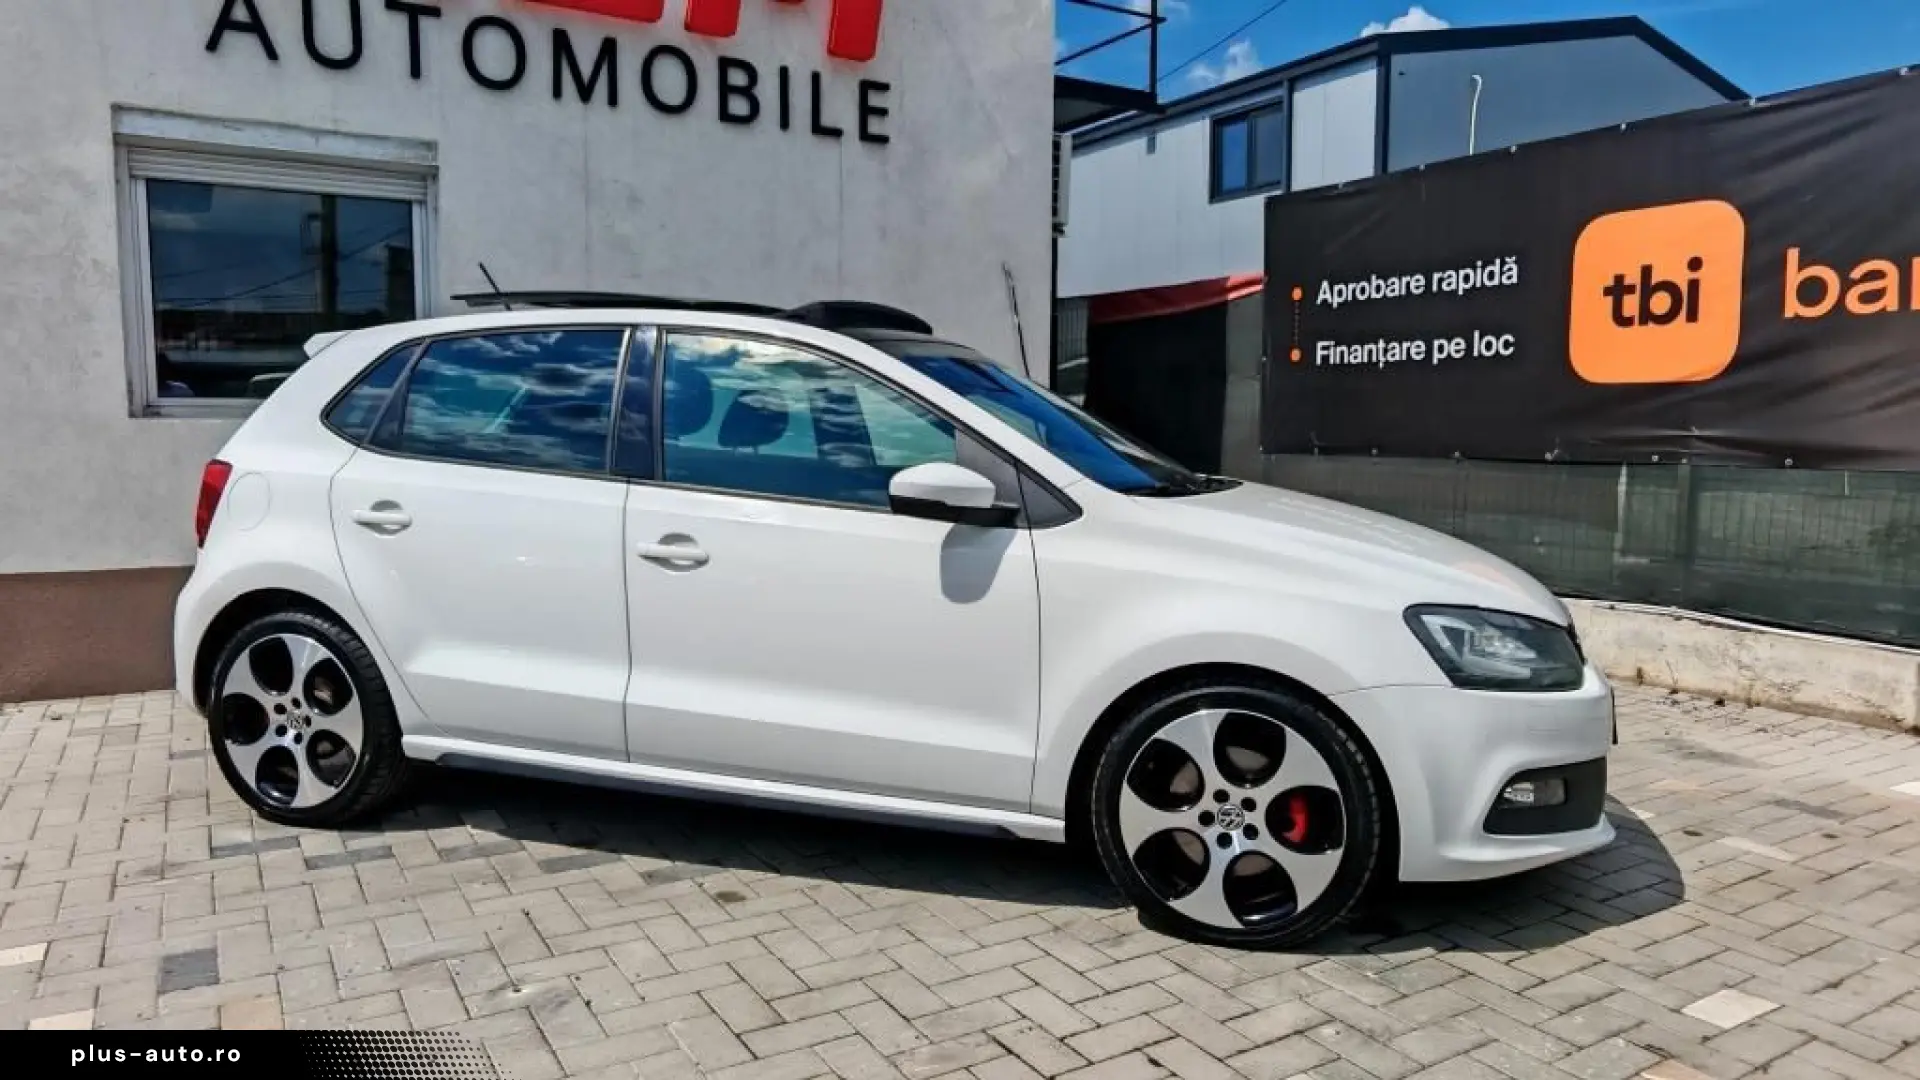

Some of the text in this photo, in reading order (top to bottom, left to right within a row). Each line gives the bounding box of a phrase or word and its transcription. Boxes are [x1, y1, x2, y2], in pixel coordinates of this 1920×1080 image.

[205, 0, 891, 145] AUTOMOBILE
[1316, 255, 1519, 309] Aprobare rapidă
[1602, 247, 1920, 328] tbi ba
[1315, 330, 1516, 369] Finanțare pe loc
